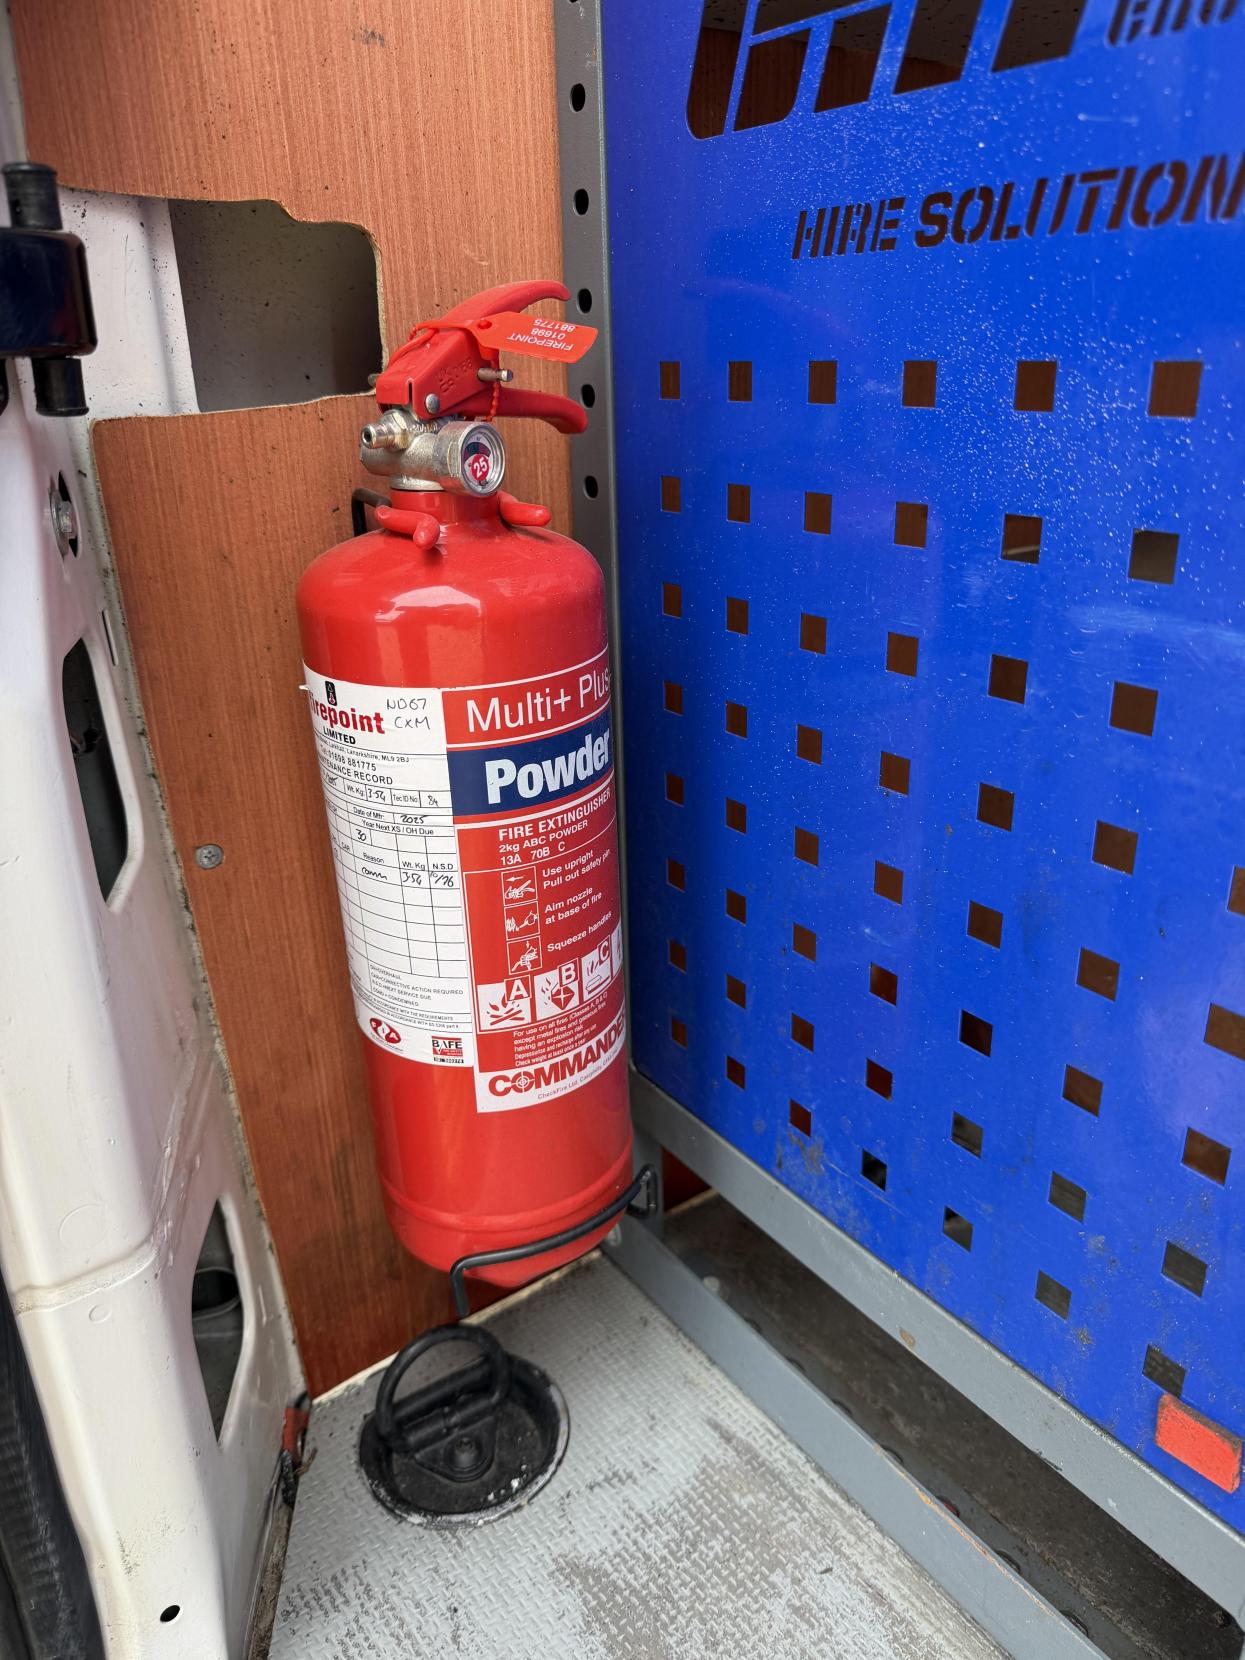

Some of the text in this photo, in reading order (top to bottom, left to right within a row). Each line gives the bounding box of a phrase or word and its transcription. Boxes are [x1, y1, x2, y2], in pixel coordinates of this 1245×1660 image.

[791, 196, 906, 260] HIRE
[530, 327, 566, 341] 01698
[533, 319, 576, 333] 881775
[506, 332, 574, 351] FIREPOINT
[473, 456, 488, 479] 25
[466, 688, 572, 733] Multi+
[323, 726, 356, 745] LIMITED
[347, 757, 377, 772] 881775
[381, 754, 395, 763] ML9
[485, 728, 610, 805] Powder
[353, 768, 393, 785] RECORD
[353, 807, 365, 817] Date
[400, 815, 428, 824] 2025
[499, 787, 611, 841] FIRE EXTINGUISHER
[362, 819, 374, 829] Year
[376, 823, 390, 832] Next
[391, 825, 401, 833] XS
[405, 827, 418, 835] OH
[419, 828, 434, 836] Due
[499, 819, 588, 853] 2kg ABC POWDER
[362, 853, 384, 864] Reason
[500, 841, 566, 866] 13A 70B C
[414, 863, 425, 871] Kg
[542, 850, 594, 878] Use upright
[543, 876, 562, 889] Pull
[565, 872, 579, 882] out
[581, 856, 601, 875] safety
[545, 887, 593, 913] Aim nozzle
[546, 892, 602, 925] at base of fire
[547, 910, 612, 952] Squeeze handles
[600, 941, 609, 960] C
[561, 963, 576, 984] B
[411, 986, 432, 994] ACTION
[420, 993, 432, 1001] DUE
[509, 979, 529, 1001] A
[556, 1018, 568, 1027] fires
[514, 1036, 536, 1045] except
[537, 1030, 553, 1040] metal
[555, 1026, 566, 1034] fires
[567, 1021, 577, 1029] and
[515, 1043, 536, 1052] having
[547, 1030, 573, 1045] explosion
[432, 1040, 463, 1050] BAFE
[488, 1013, 624, 1097] COMMANDE
[516, 1058, 530, 1066] Check
[532, 1055, 547, 1064] weight
[538, 1085, 568, 1099] CheckFire
